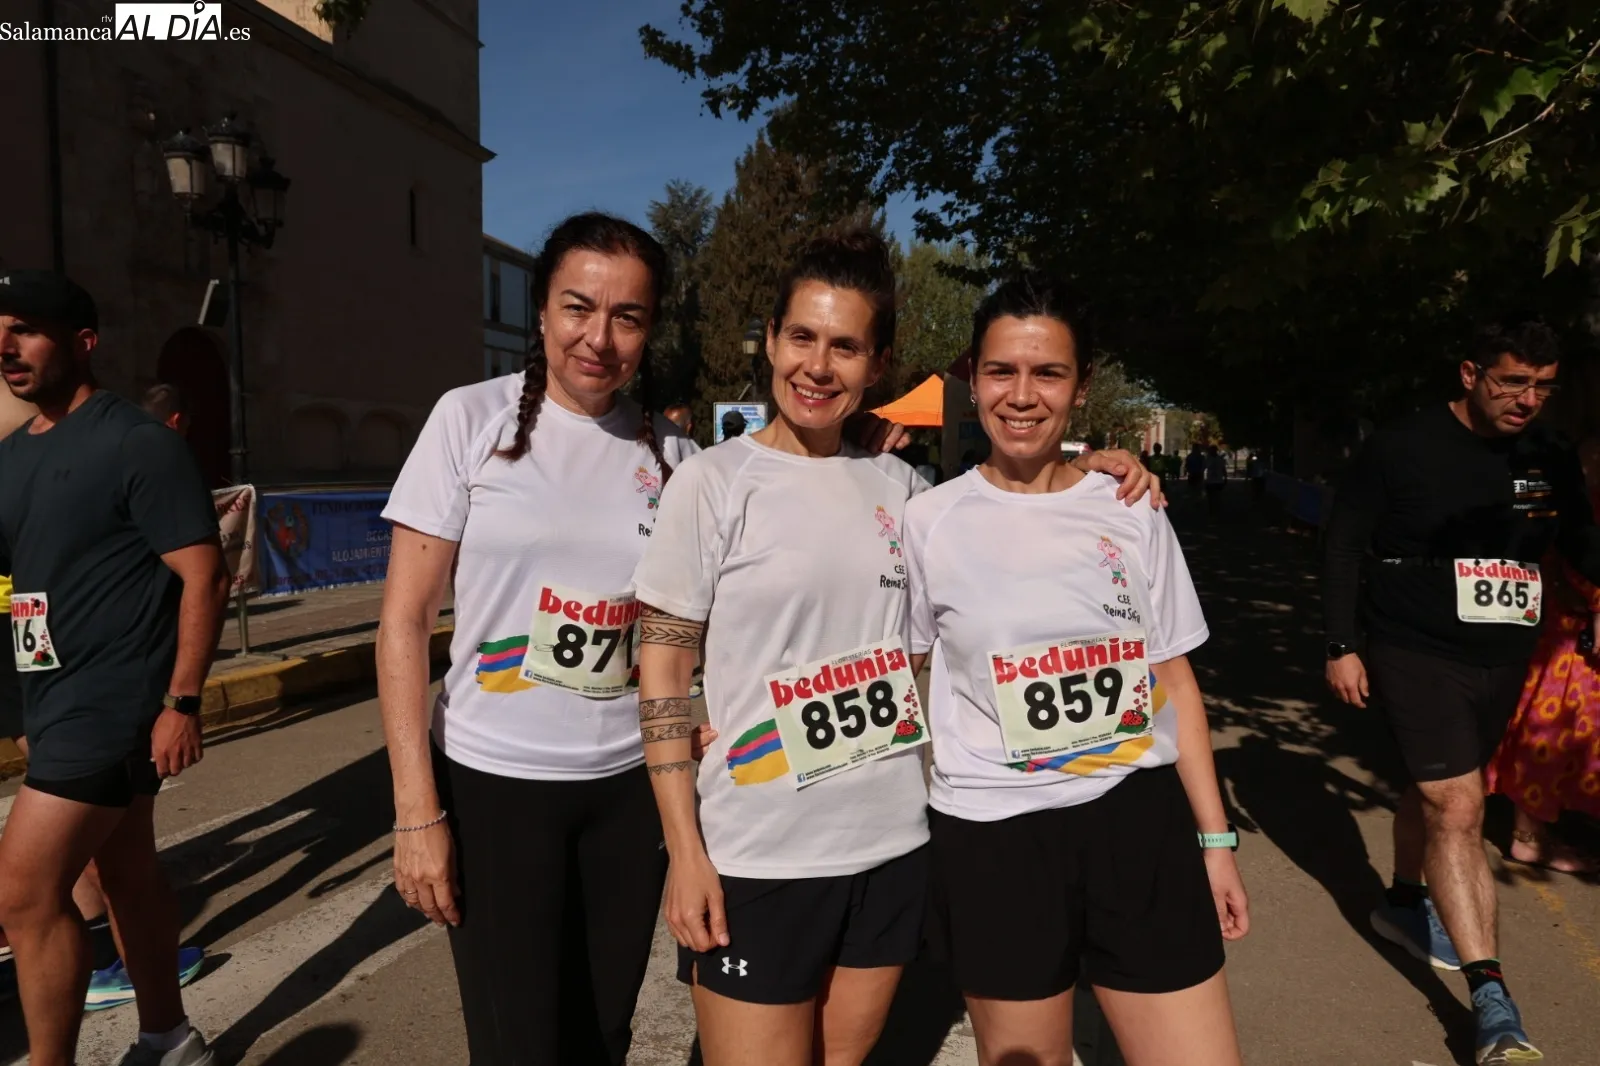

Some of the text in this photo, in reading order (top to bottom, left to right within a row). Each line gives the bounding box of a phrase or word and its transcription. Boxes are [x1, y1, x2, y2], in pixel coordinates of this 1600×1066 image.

[880, 574, 901, 590] Reina
[1457, 562, 1539, 582] bedunia
[1103, 603, 1126, 619] Reina
[1117, 594, 1131, 606] CEE
[1474, 579, 1529, 610] 865
[553, 623, 635, 674] 871
[992, 637, 1145, 686] bedunia
[769, 647, 908, 709] bedunia
[801, 680, 899, 750] 858
[1024, 667, 1124, 731] 859
